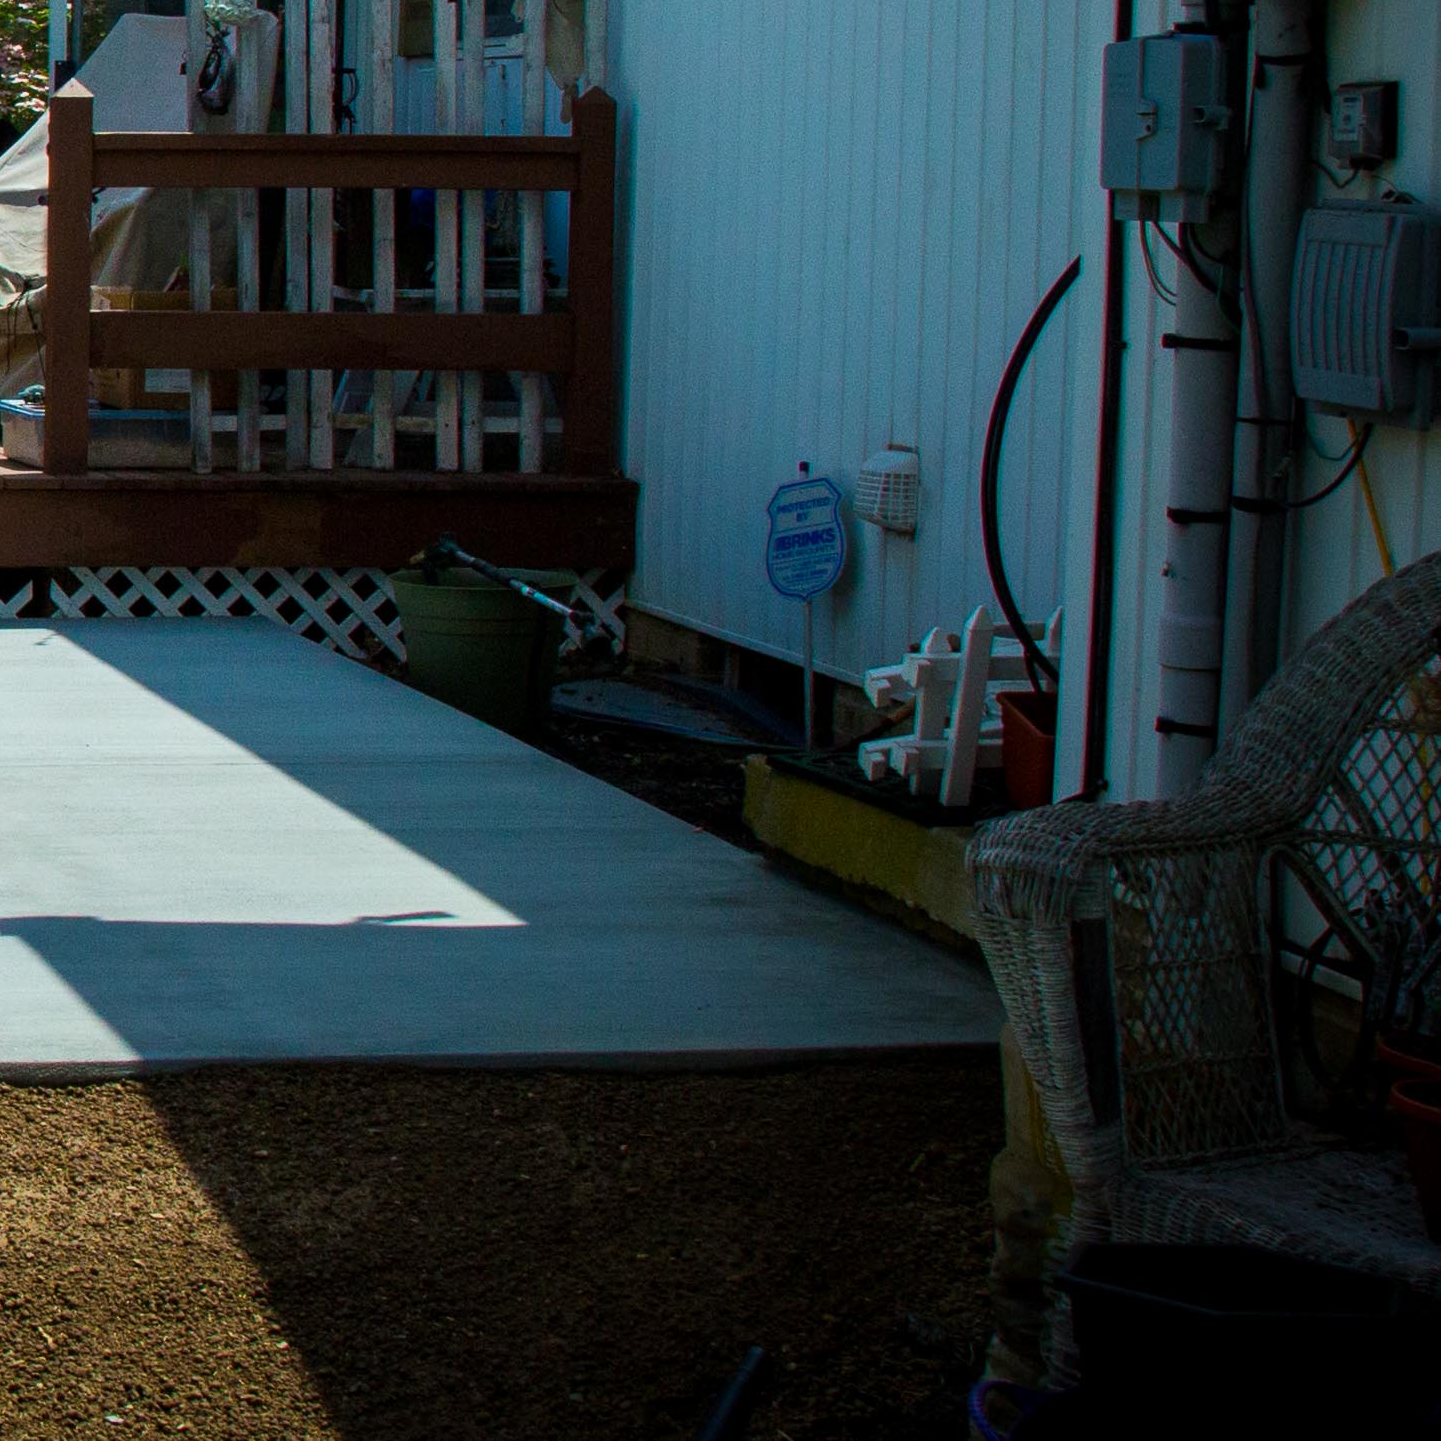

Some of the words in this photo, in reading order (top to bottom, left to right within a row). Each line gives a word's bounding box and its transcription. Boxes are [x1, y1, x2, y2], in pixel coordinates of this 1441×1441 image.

[776, 497, 830, 513] PROTECTED
[796, 512, 809, 522] BY
[781, 528, 836, 551] BRINKS
